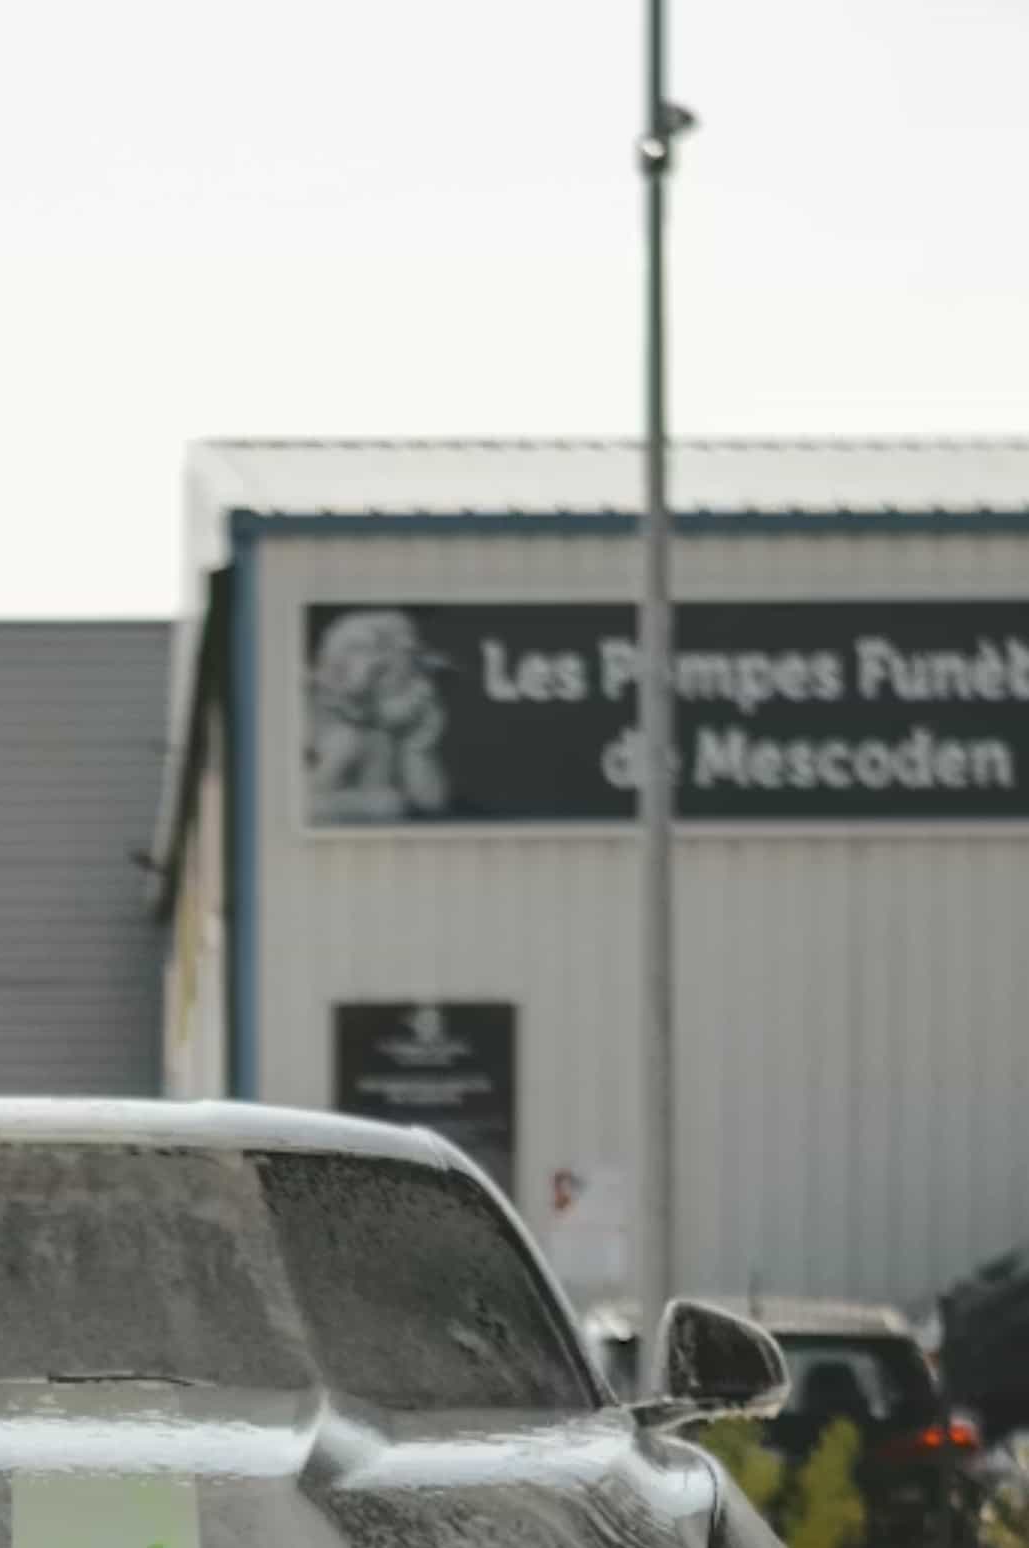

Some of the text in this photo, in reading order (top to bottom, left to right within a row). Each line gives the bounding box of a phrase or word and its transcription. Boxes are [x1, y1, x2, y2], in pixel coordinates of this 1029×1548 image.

[481, 637, 587, 701] Les
[598, 637, 843, 715] Pmpes
[693, 729, 1015, 789] Mescoden
